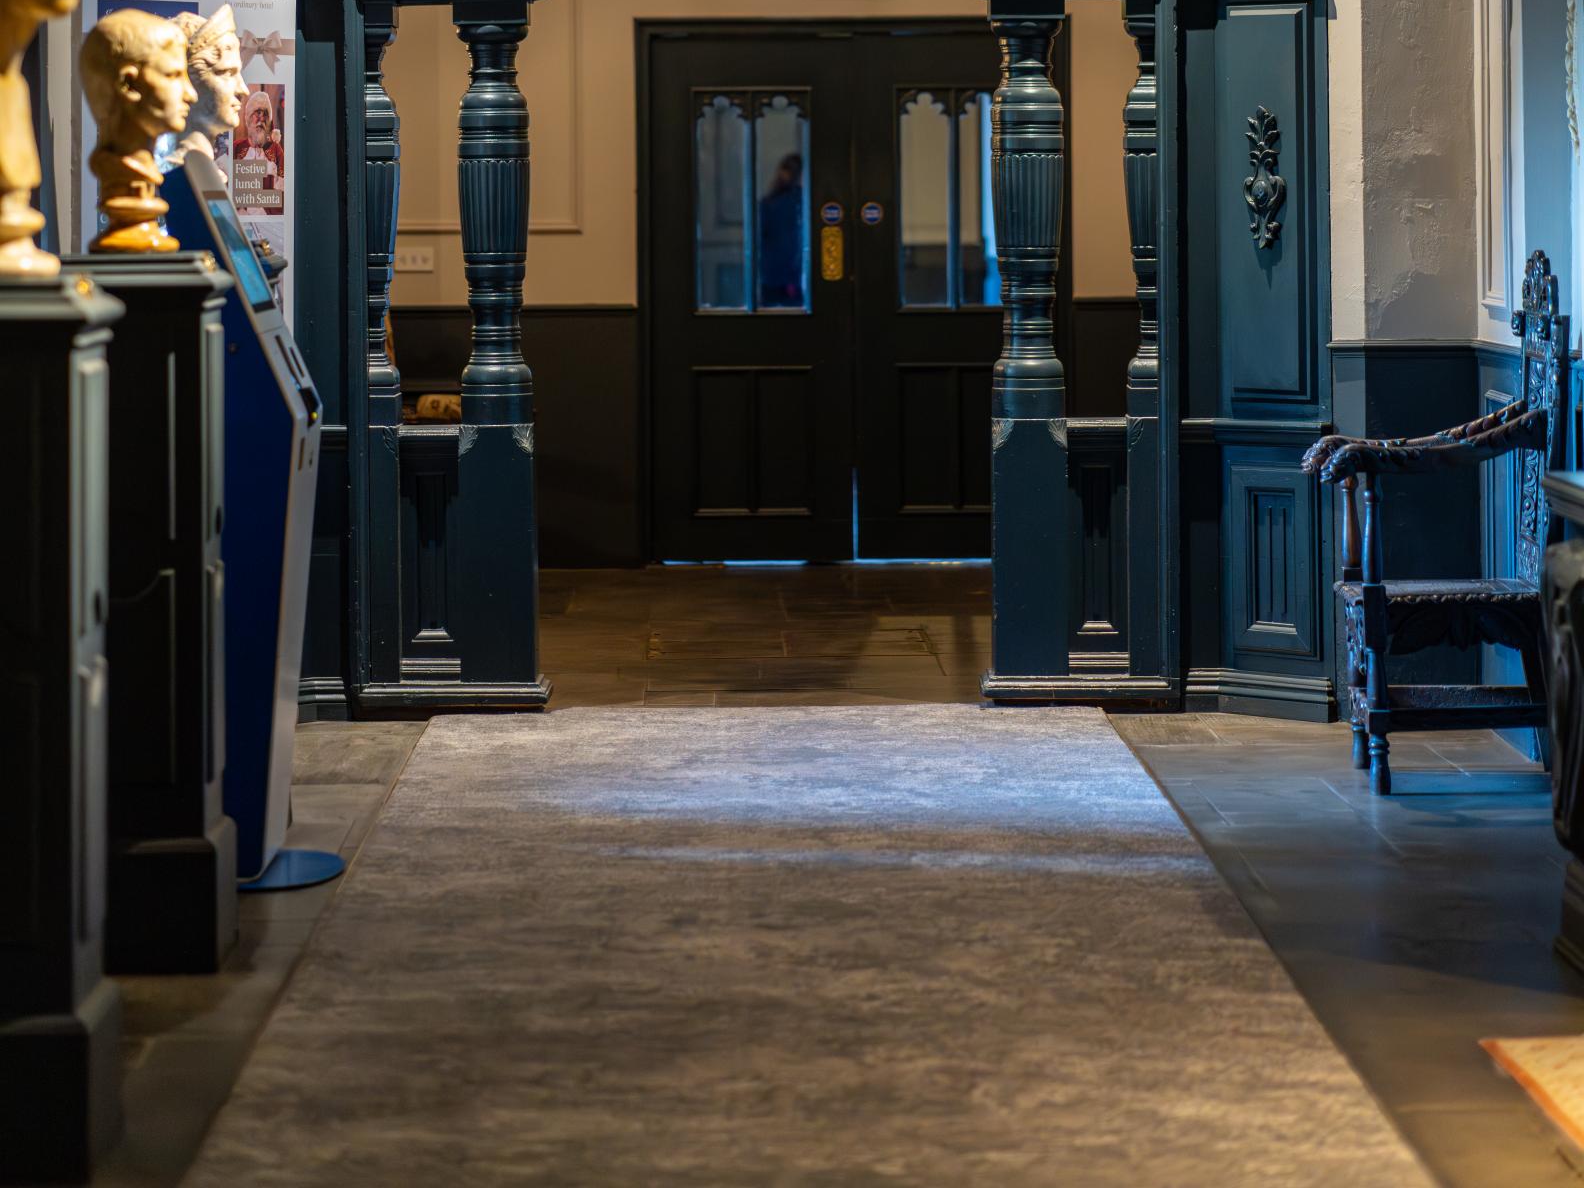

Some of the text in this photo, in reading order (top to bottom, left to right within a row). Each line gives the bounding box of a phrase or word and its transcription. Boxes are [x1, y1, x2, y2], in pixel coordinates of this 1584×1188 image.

[235, 164, 265, 174] Festive
[235, 179, 261, 189] lunch
[235, 194, 280, 204] with Santa
